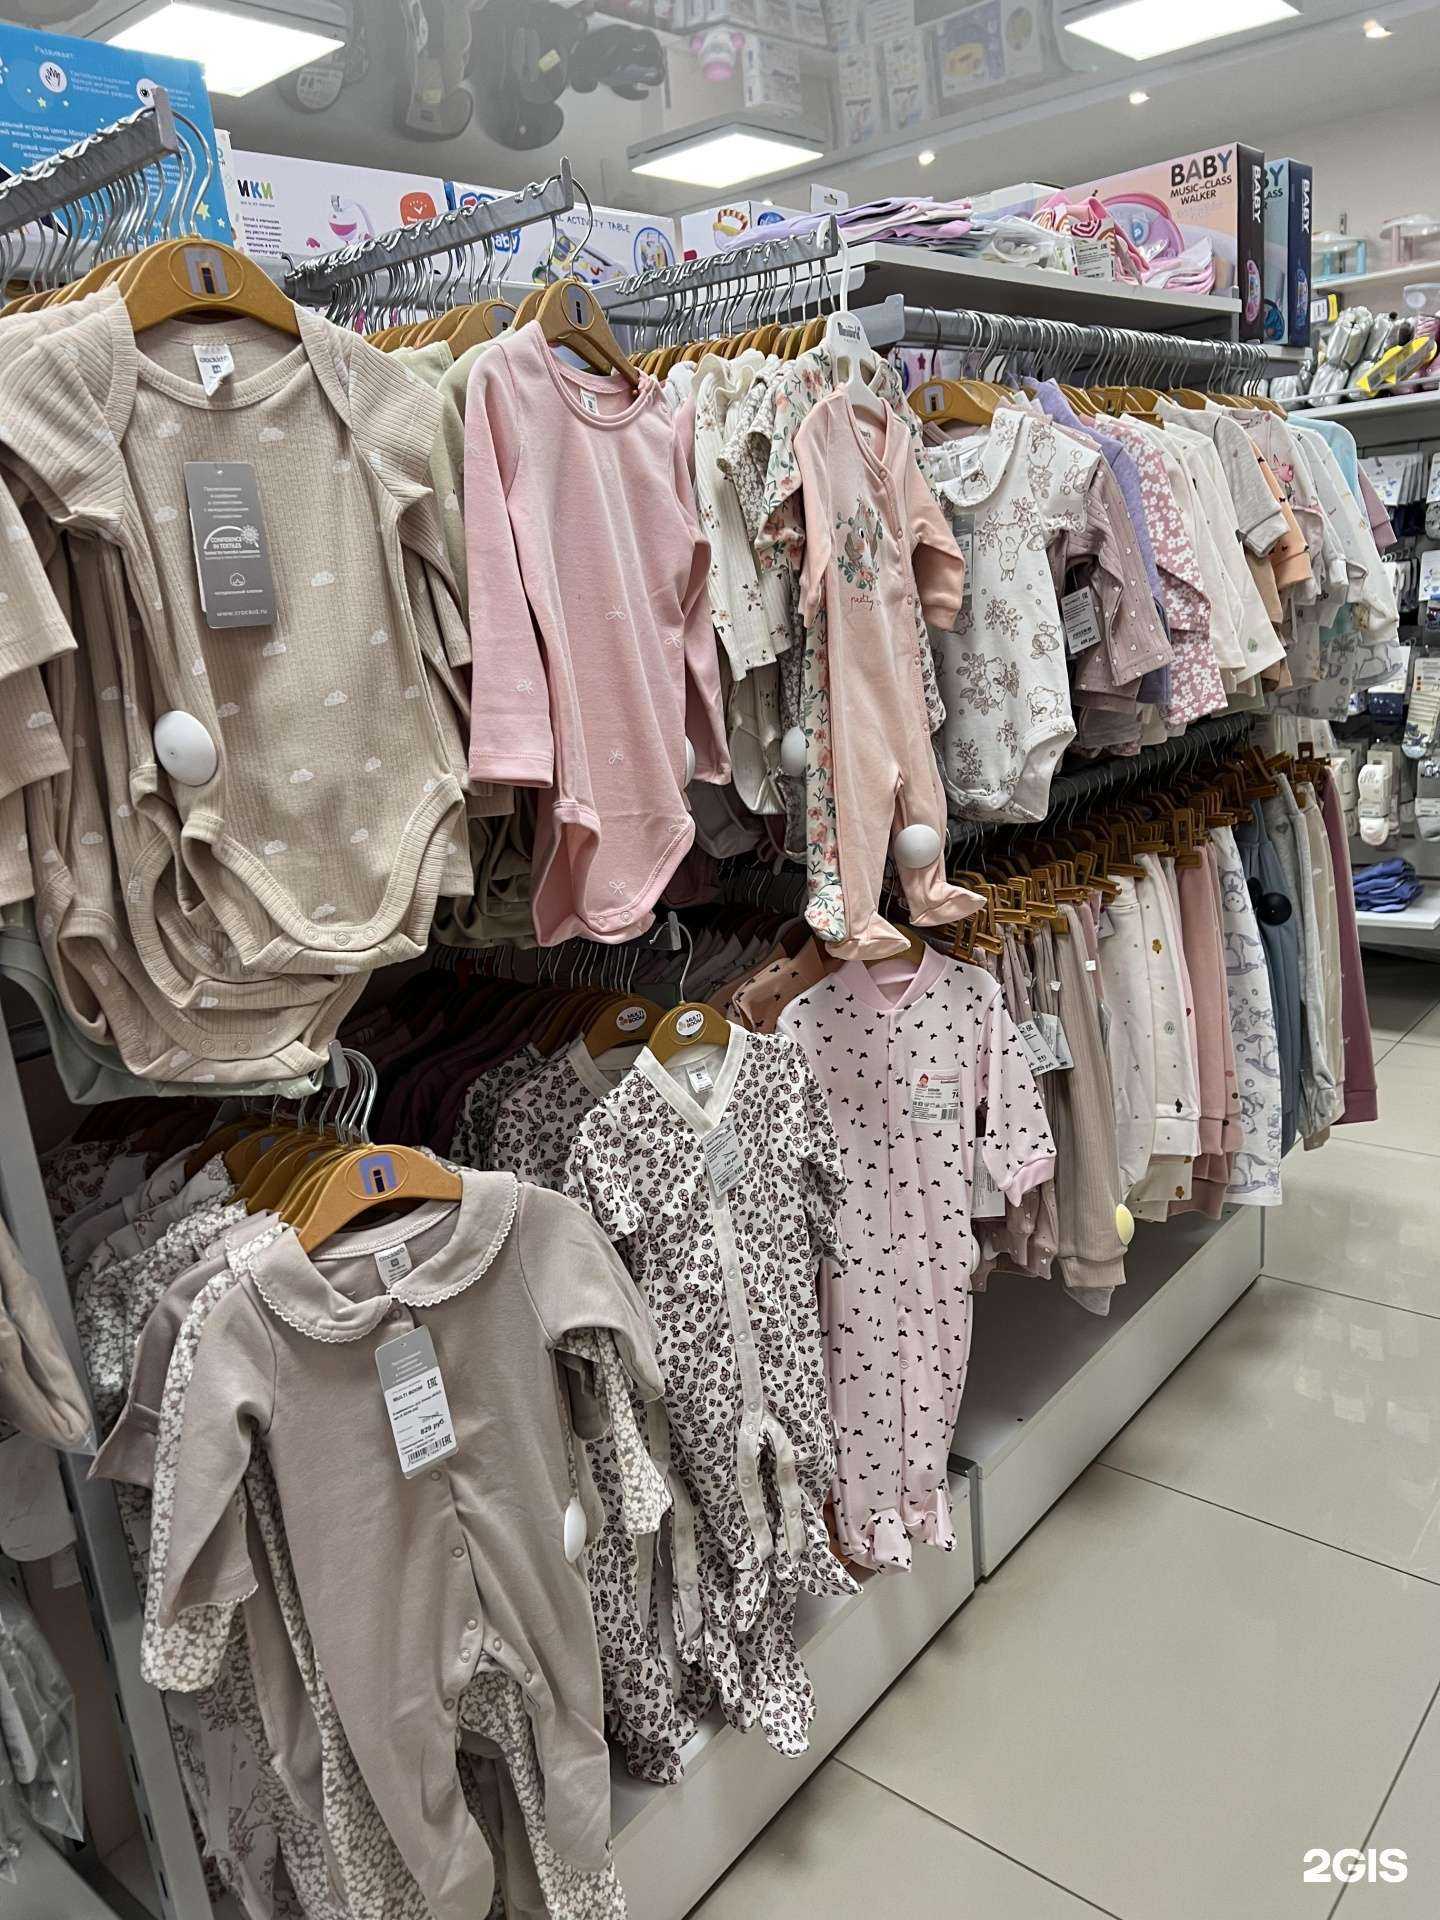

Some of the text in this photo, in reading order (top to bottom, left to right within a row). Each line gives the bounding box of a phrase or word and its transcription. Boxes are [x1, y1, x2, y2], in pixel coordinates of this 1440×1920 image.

[1170, 149, 1232, 187] BABY
[1180, 189, 1217, 205] WALKER
[1251, 164, 1261, 223] BABY
[1301, 178, 1310, 234] BABY
[608, 221, 631, 233] TABLE
